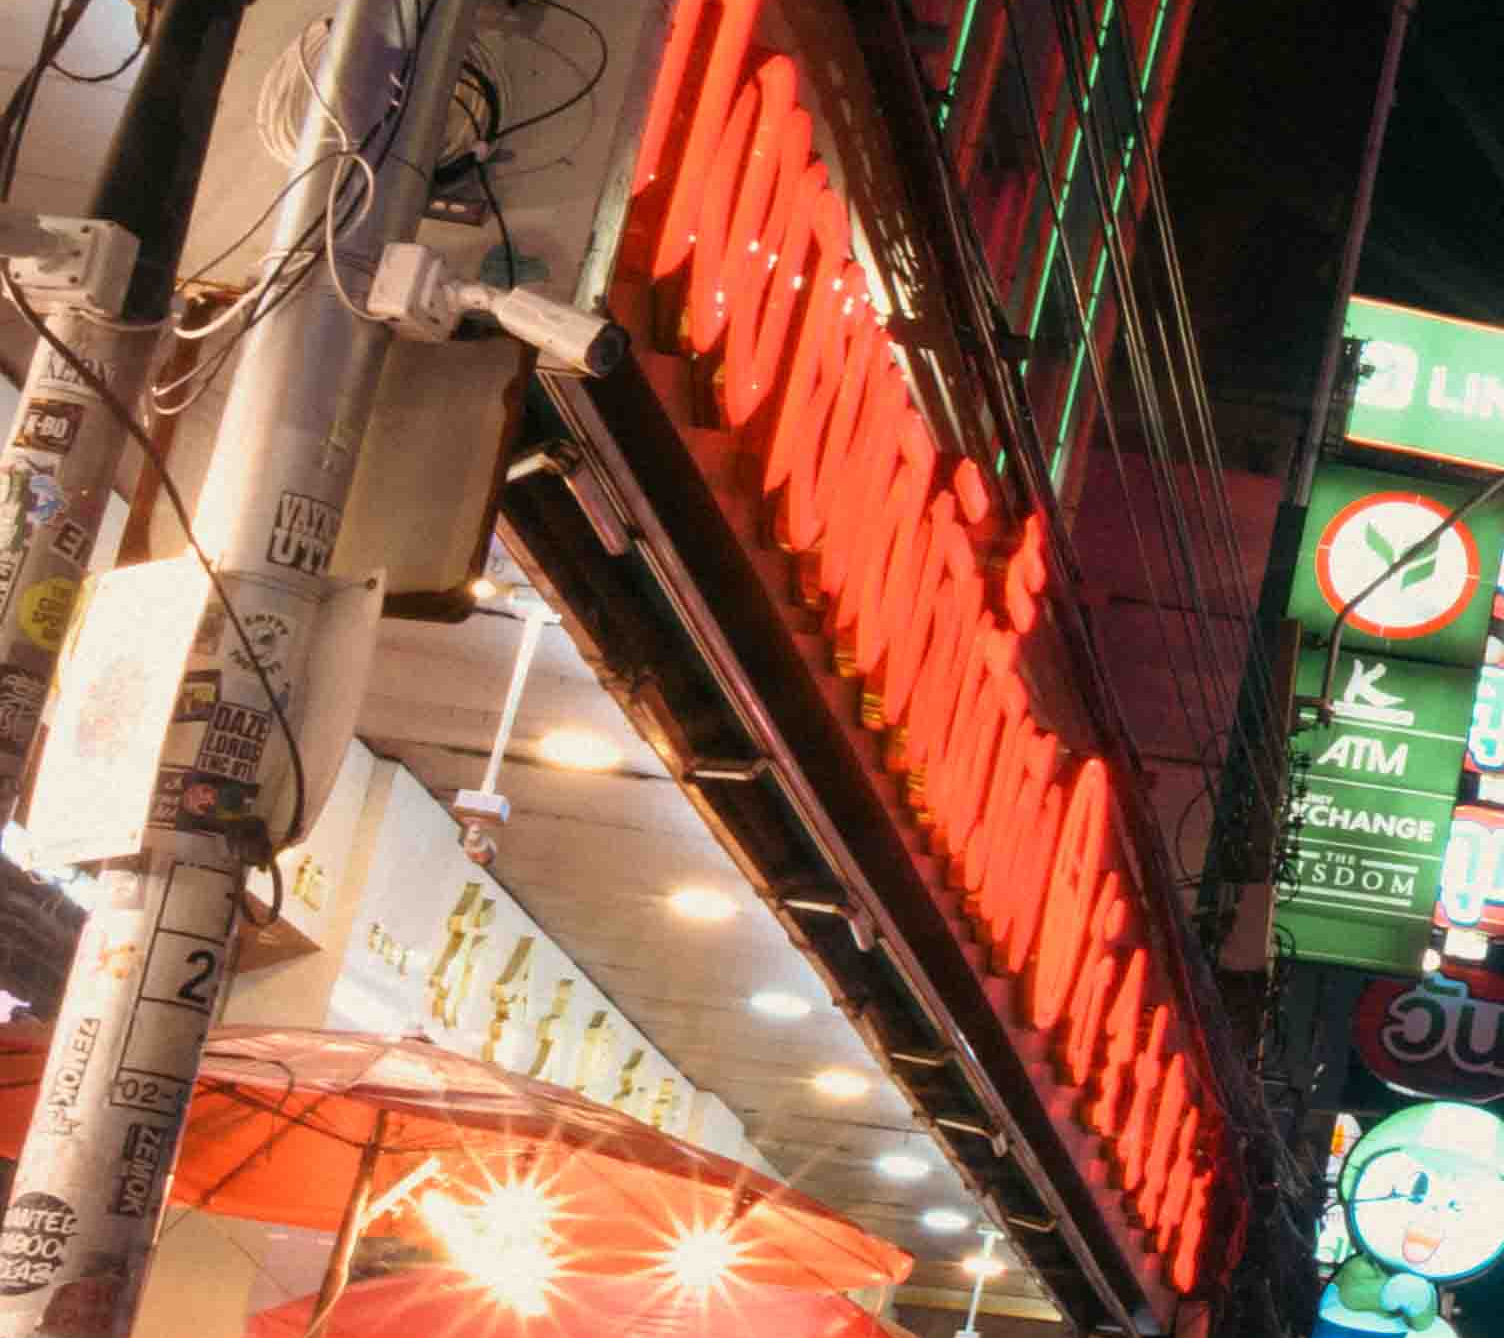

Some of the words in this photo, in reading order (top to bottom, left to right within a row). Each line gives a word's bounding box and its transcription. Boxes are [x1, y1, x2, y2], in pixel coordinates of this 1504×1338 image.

[1317, 734, 1409, 776] ATM
[1288, 799, 1437, 844] XCHANGE
[177, 950, 216, 1006] 2
